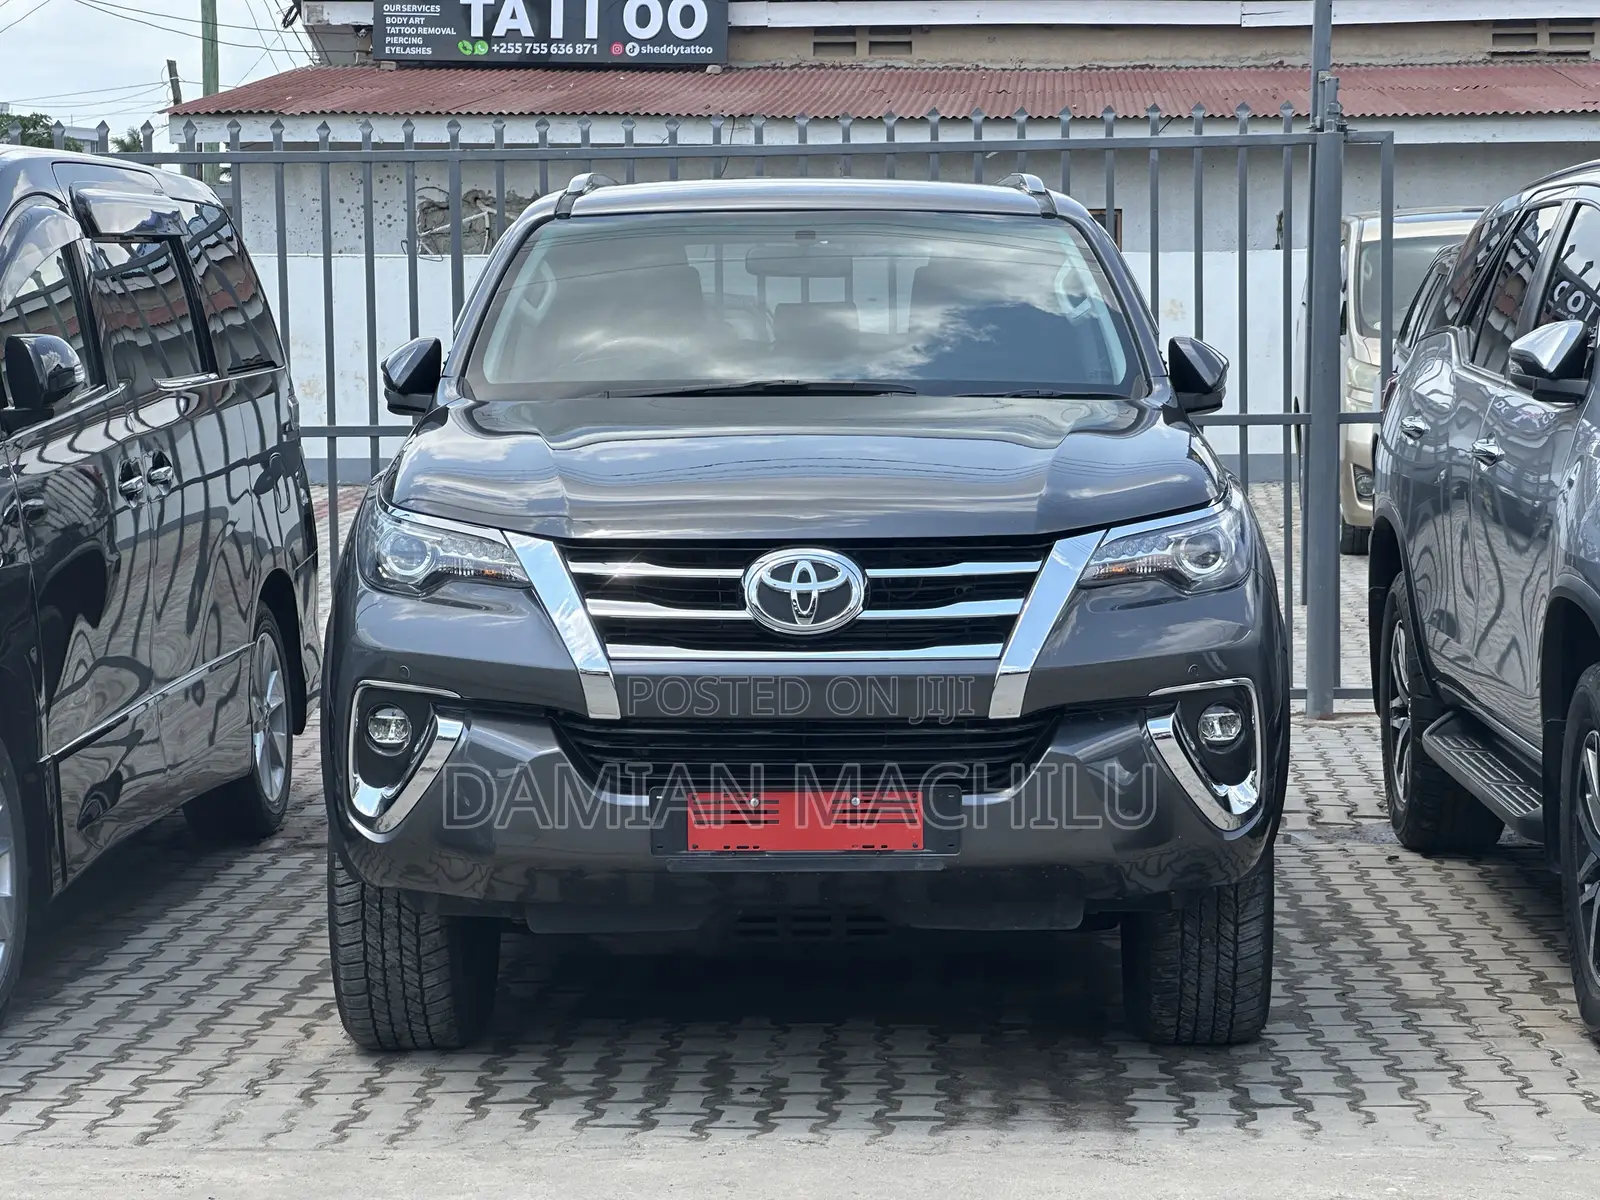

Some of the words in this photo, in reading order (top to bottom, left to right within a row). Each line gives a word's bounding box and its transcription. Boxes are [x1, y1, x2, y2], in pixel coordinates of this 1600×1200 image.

[383, 4, 401, 12] OUR
[401, 4, 440, 13] SERVICES
[408, 17, 425, 25] ART
[386, 26, 416, 34] TATTOO
[417, 27, 456, 35] REMOVAL
[385, 36, 423, 45] PIERCING
[385, 46, 432, 55] EYELASHES
[492, 43, 522, 54] +255
[525, 43, 548, 54] 755
[550, 43, 573, 55] 636
[575, 44, 598, 55] 871
[641, 44, 713, 56] sheddytattoo
